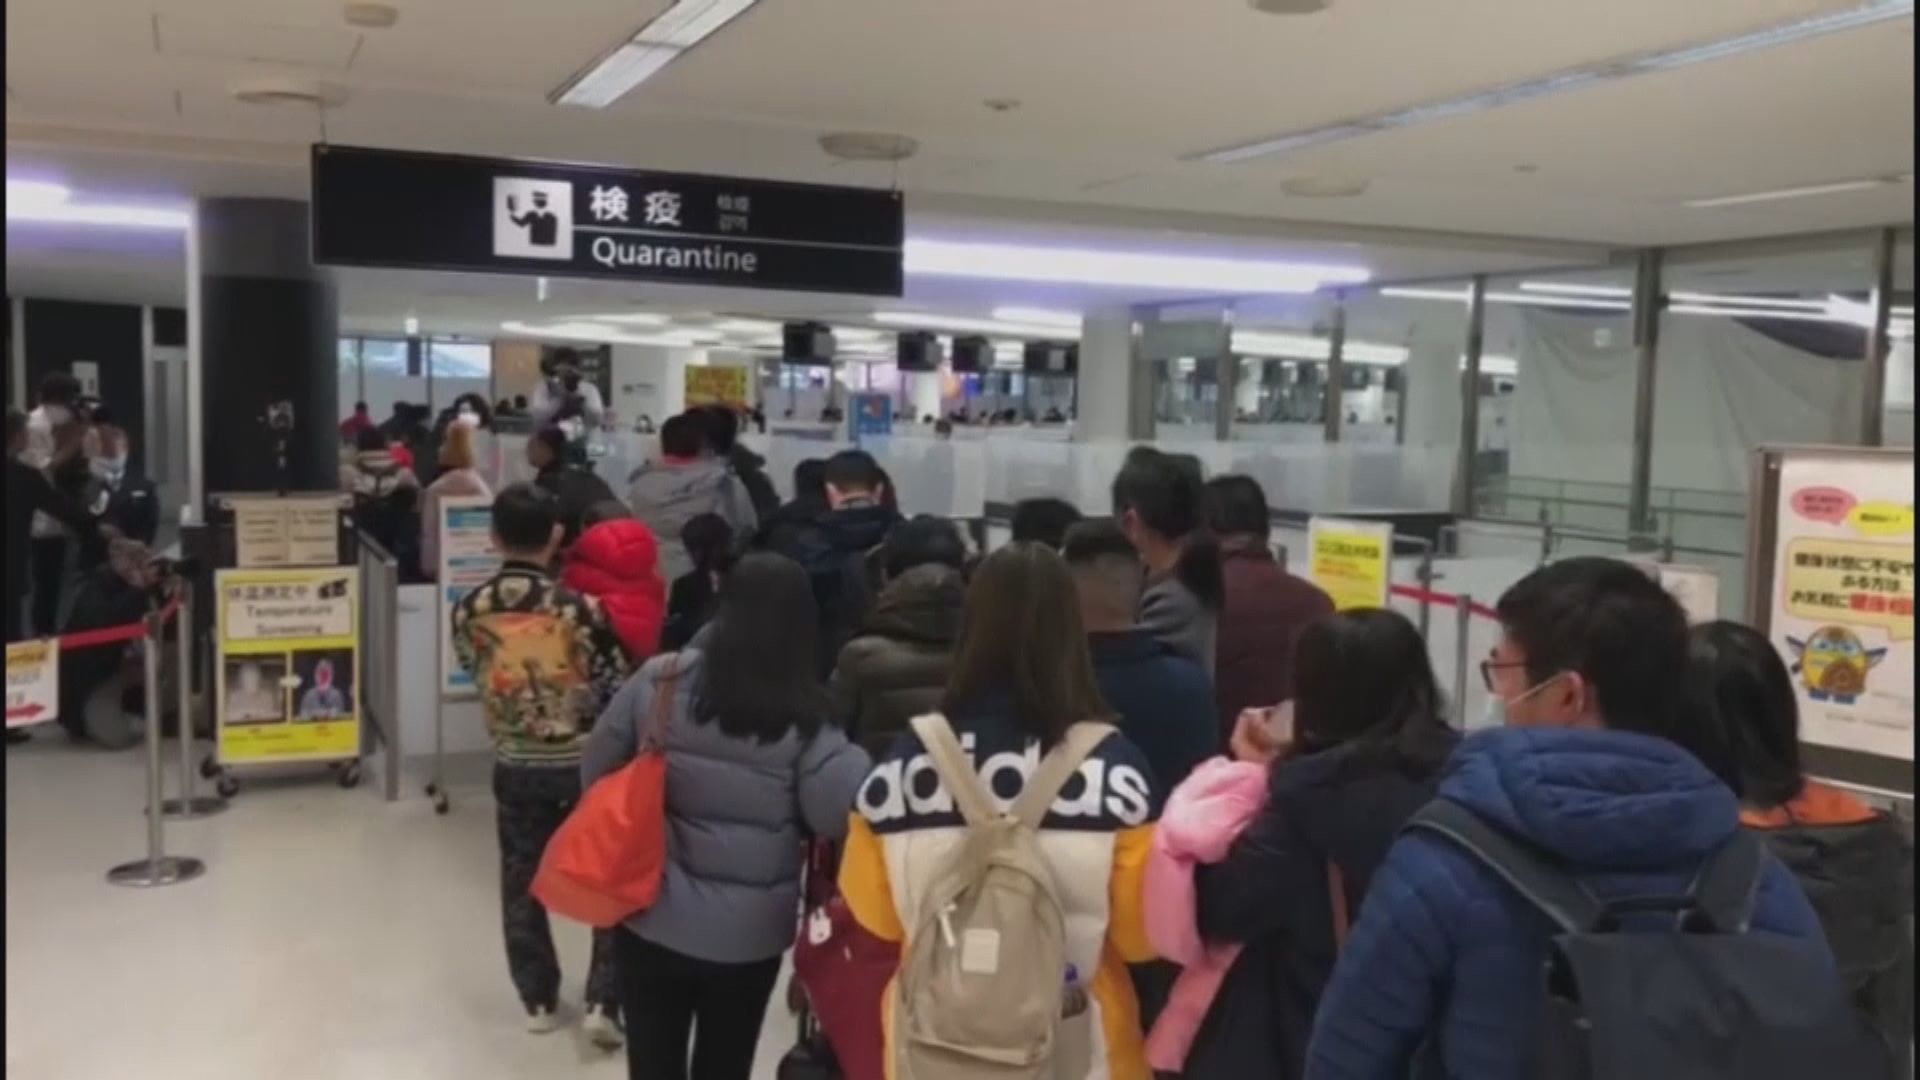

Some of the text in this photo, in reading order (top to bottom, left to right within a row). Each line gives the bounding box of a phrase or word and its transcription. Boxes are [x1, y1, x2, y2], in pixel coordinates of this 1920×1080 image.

[590, 185, 682, 227] 検疫
[592, 236, 758, 272] Quarantine
[246, 604, 333, 618] Temperature
[256, 623, 323, 635] Screening
